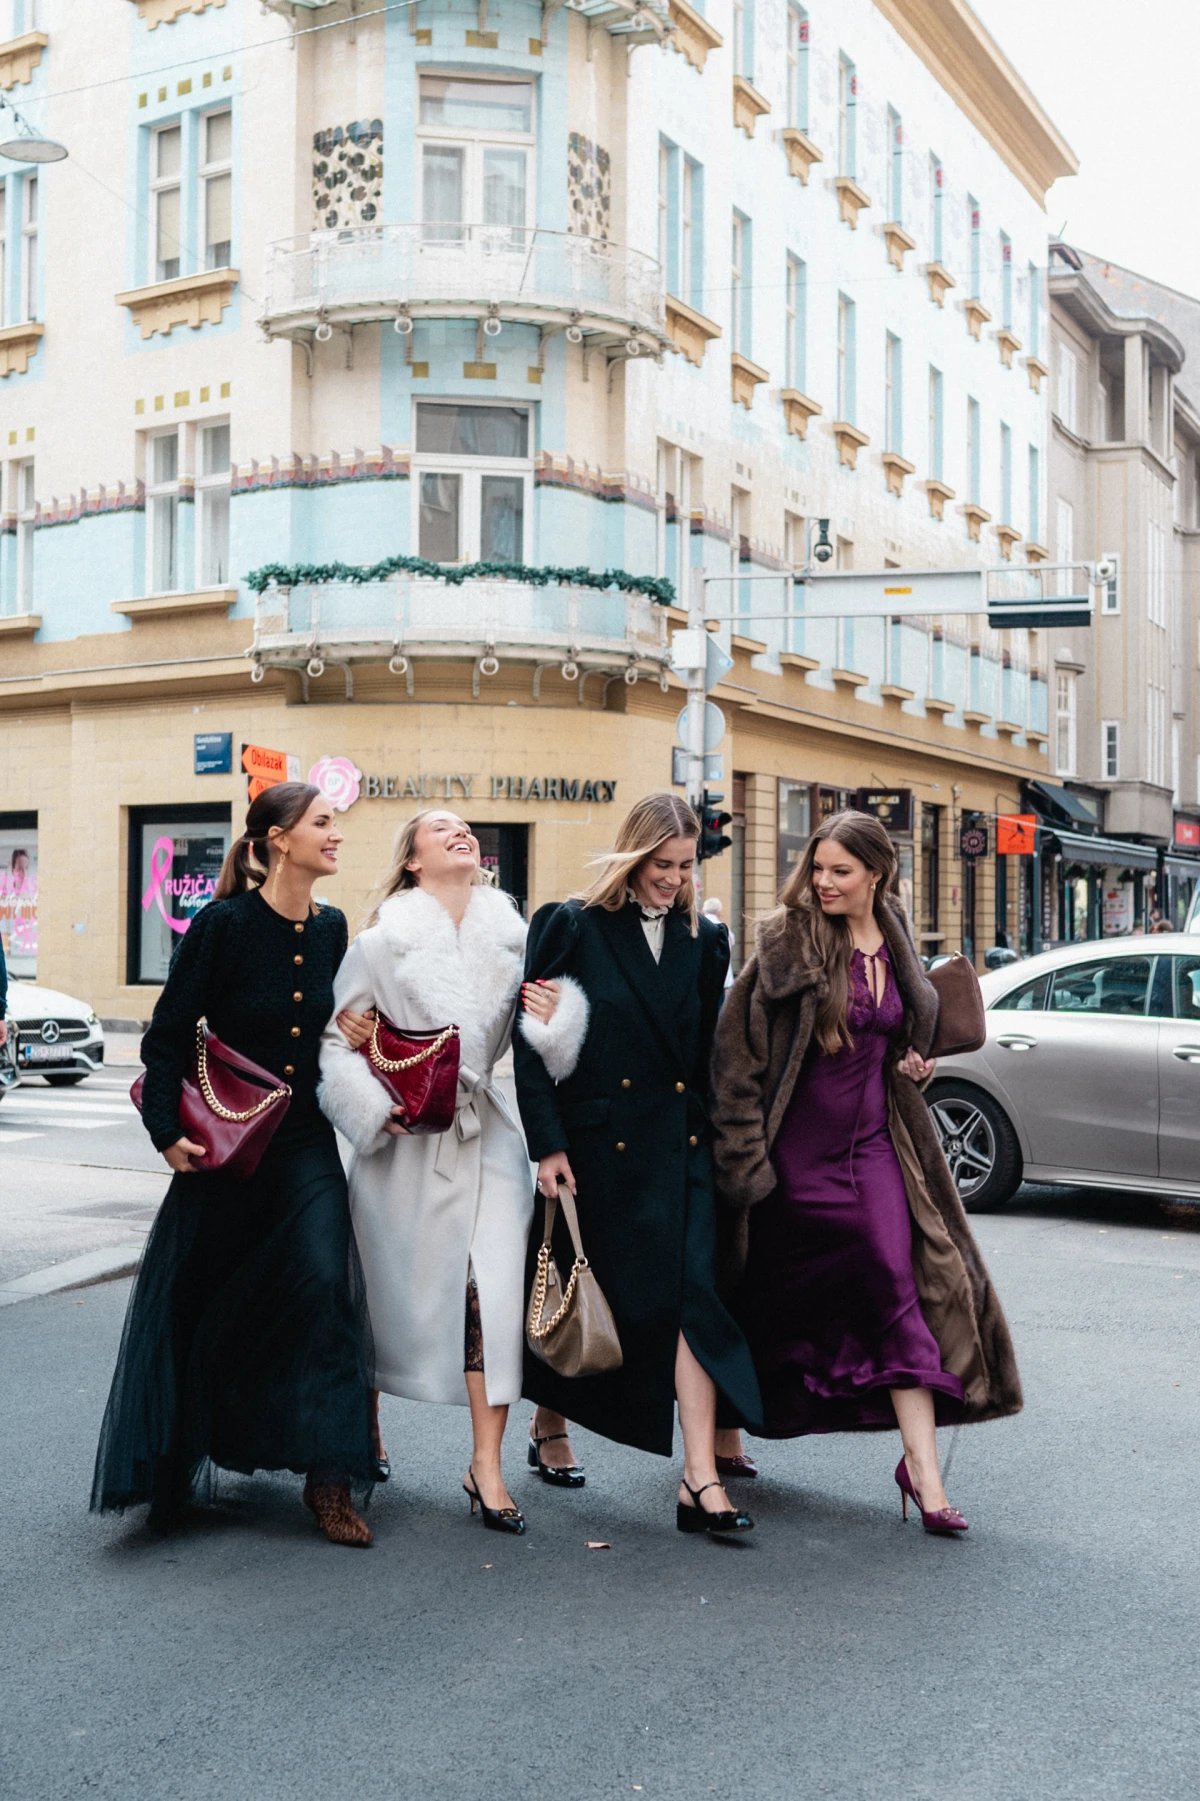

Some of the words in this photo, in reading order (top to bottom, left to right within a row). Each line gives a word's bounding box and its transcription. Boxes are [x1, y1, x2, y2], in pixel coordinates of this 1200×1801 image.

[251, 749, 283, 770] Obilazak
[364, 774, 476, 799] BEAUTY
[491, 776, 618, 802] PHARMACY
